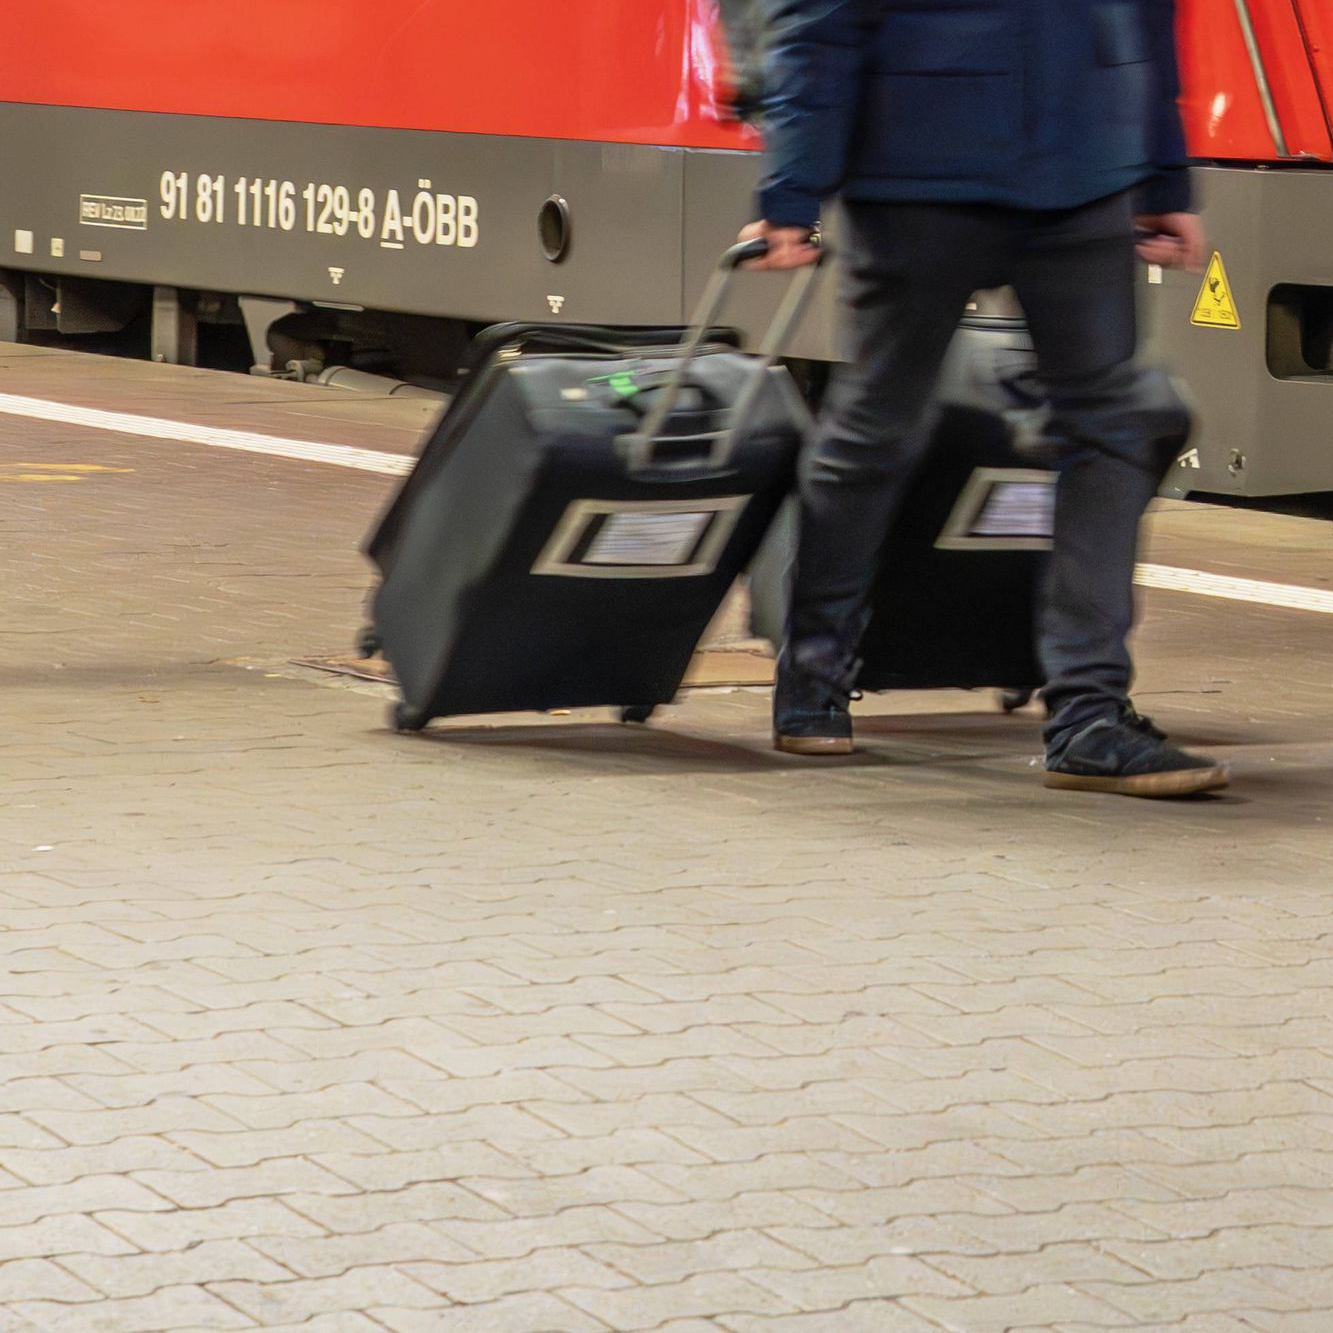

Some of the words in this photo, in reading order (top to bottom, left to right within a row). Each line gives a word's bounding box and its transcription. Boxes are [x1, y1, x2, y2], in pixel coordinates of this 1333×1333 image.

[160, 170, 188, 220] 91
[196, 173, 224, 224] 81
[234, 176, 296, 231] 1116
[303, 182, 375, 239] 129-8
[380, 178, 479, 249] A-ÖBB
